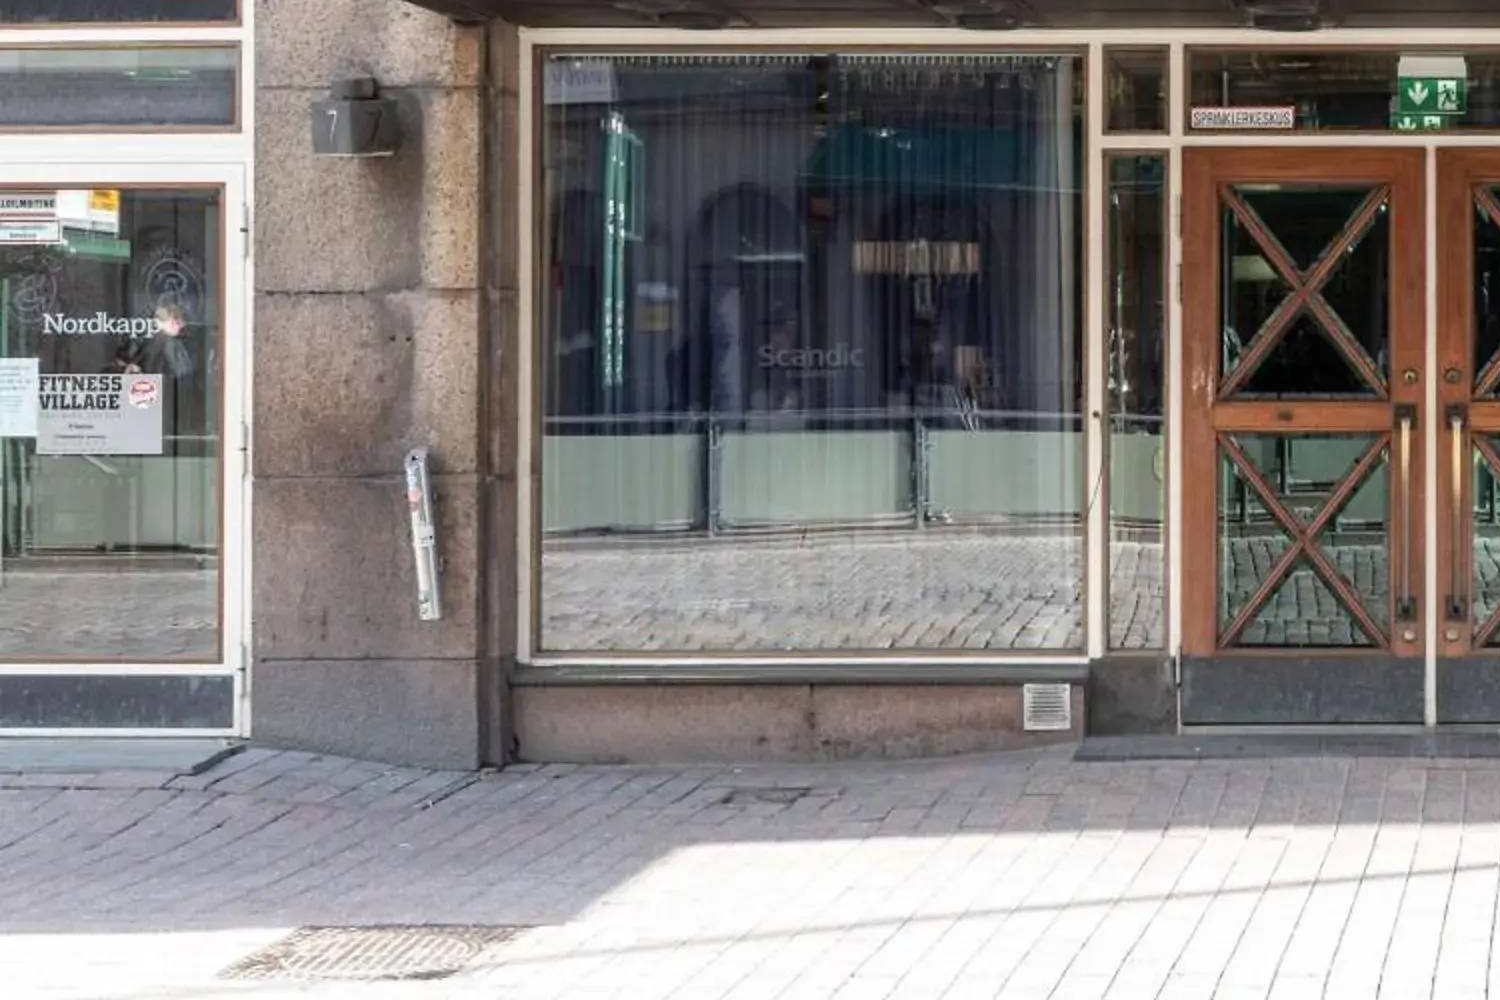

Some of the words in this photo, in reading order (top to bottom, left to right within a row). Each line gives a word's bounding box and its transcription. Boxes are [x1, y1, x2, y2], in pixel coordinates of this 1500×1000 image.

[326, 109, 338, 146] 7
[42, 312, 162, 339] Nordkapp
[757, 342, 865, 368] Scandic
[39, 376, 123, 392] FITNESS
[39, 394, 121, 411] VILLAGE
